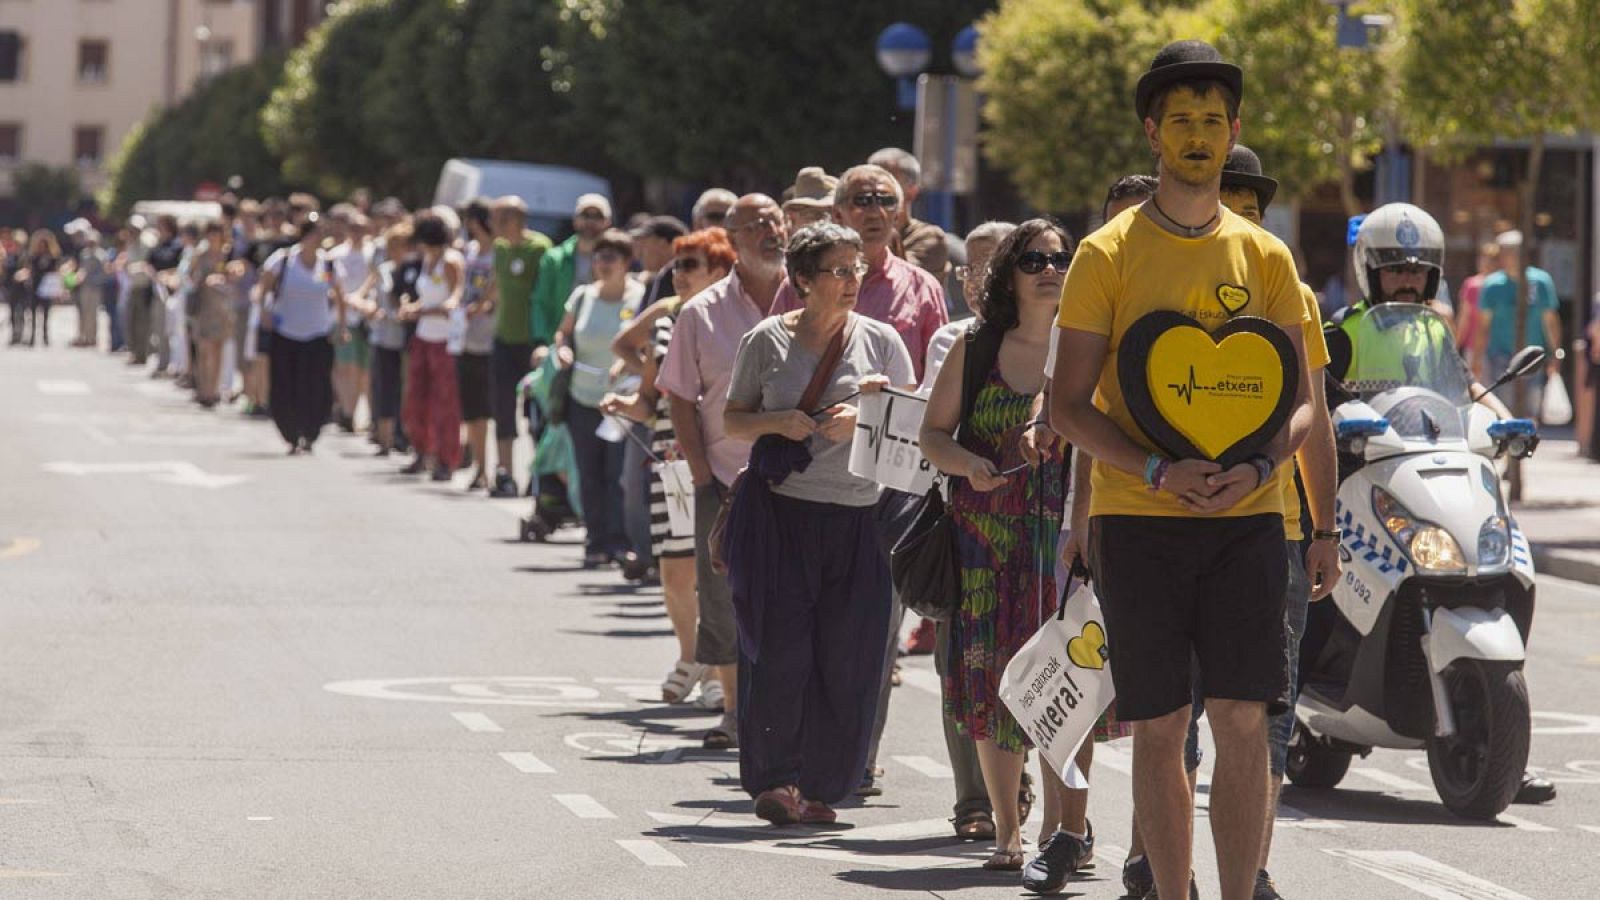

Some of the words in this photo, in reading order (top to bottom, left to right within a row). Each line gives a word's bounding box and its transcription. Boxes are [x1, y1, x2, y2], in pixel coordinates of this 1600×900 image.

[1216, 379, 1264, 393] etxera!
[1031, 656, 1061, 697] gaixoak
[1032, 671, 1084, 750] etxera!
